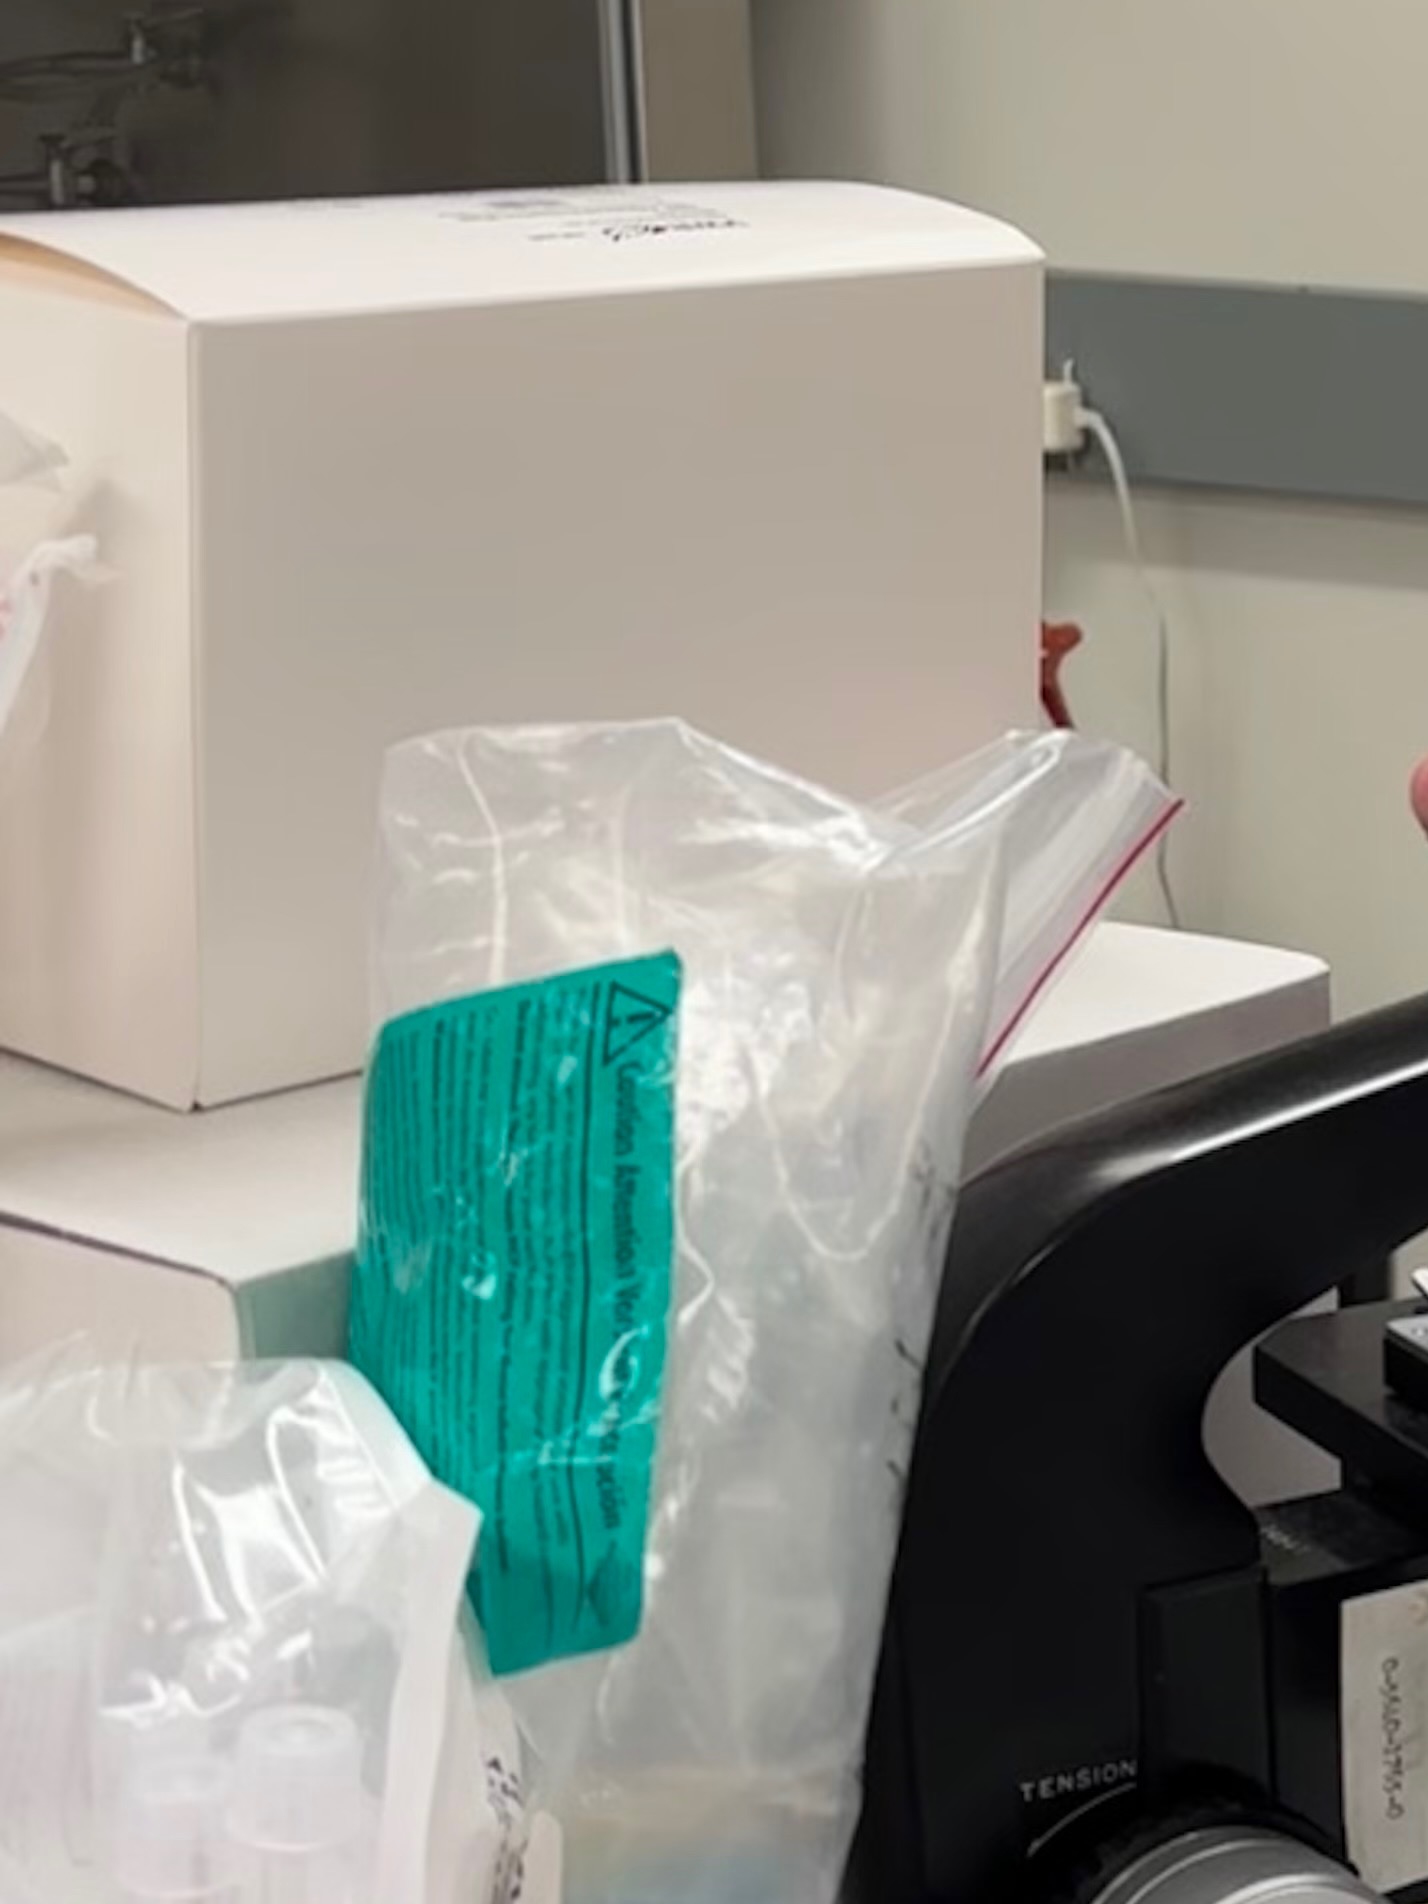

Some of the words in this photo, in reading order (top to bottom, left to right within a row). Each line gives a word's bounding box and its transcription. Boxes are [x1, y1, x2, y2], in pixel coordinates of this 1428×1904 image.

[611, 1061, 642, 1156] Caution
[609, 1163, 641, 1279] Attention
[1019, 1757, 1140, 1804] TENSION
